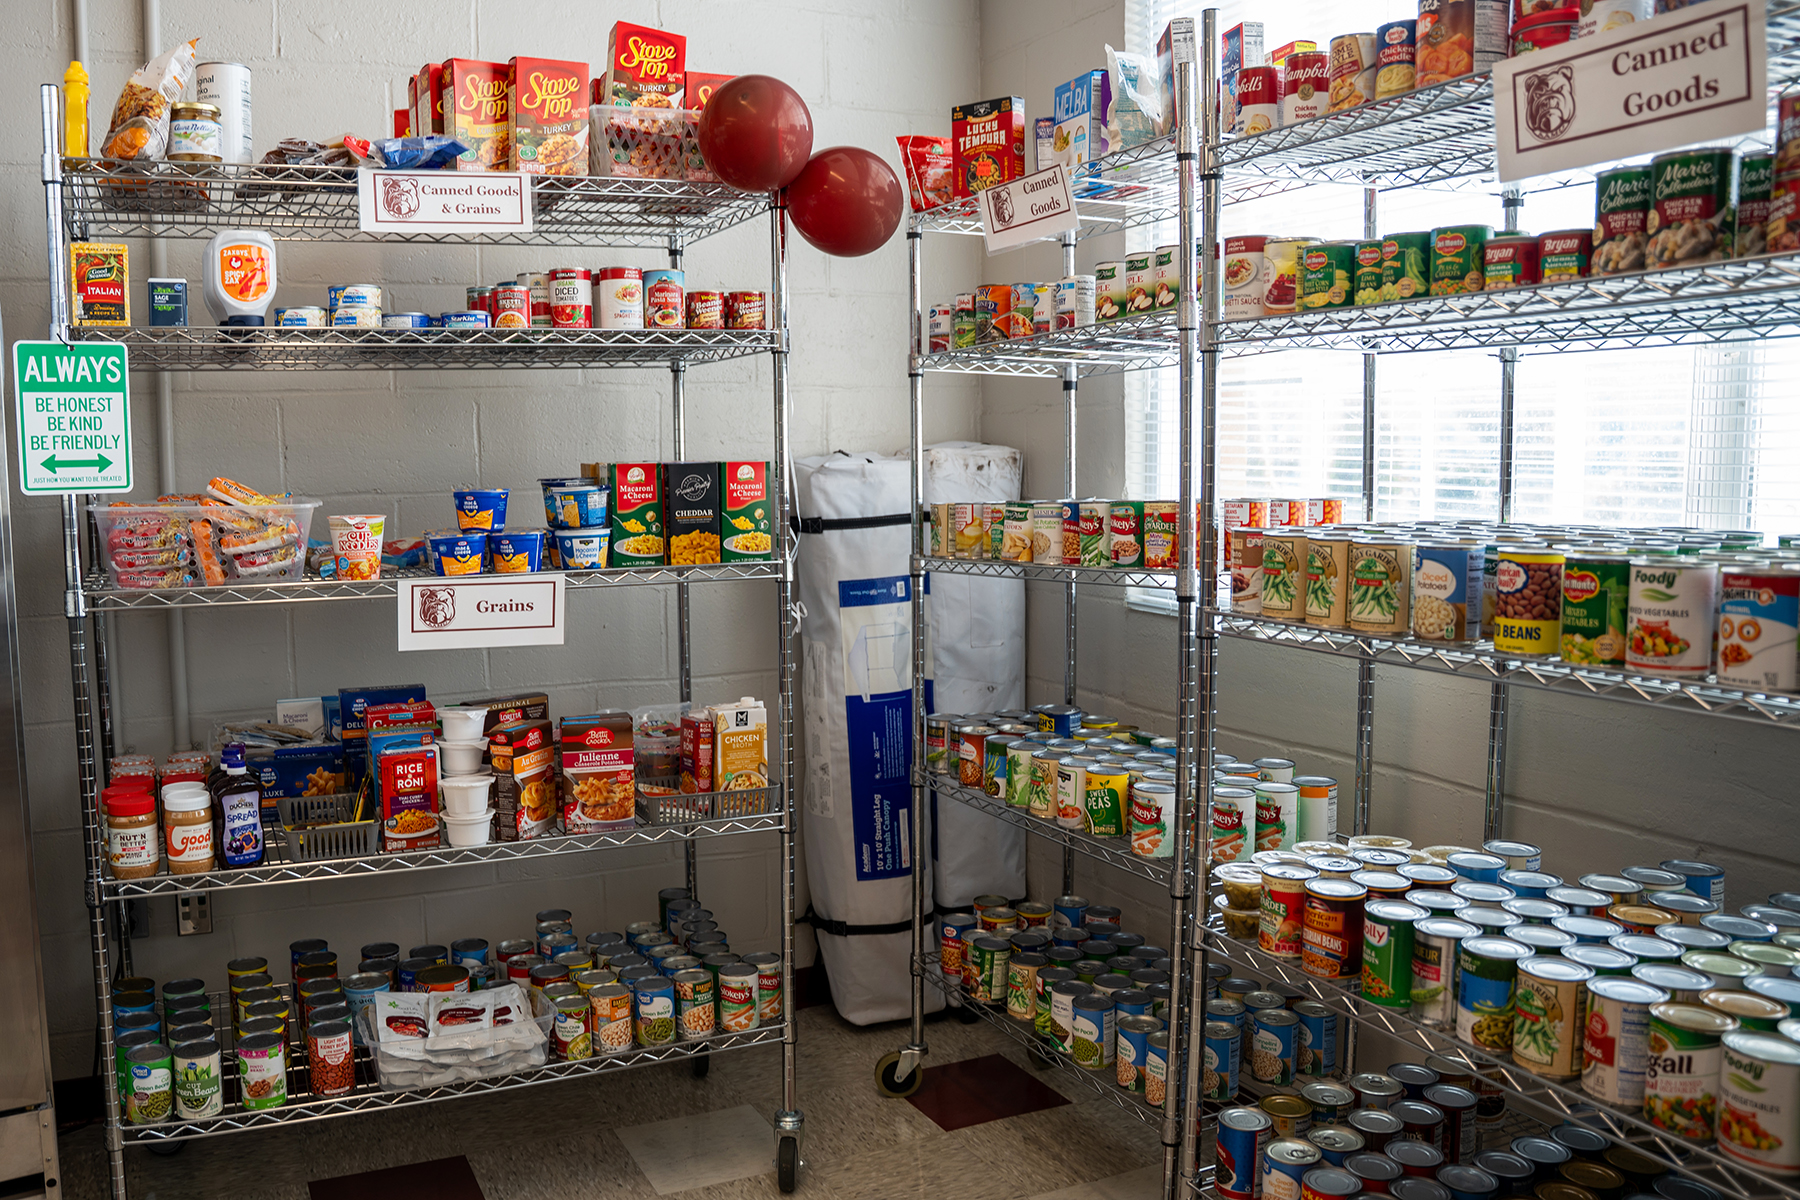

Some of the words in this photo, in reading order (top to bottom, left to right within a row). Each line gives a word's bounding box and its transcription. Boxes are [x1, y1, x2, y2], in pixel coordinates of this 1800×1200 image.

[620, 36, 676, 68] Stove
[1380, 45, 1415, 59] Chicken
[1611, 20, 1729, 76] Canned
[1381, 52, 1412, 63] Noodle
[639, 60, 668, 79] Top
[522, 72, 580, 110] Stove
[639, 83, 667, 92] TURKEY
[1623, 74, 1720, 117] Goods
[542, 97, 572, 121] Top
[1055, 84, 1088, 124] MELBA
[1294, 105, 1318, 113] Chicken
[543, 123, 572, 135] TURKEY
[967, 120, 998, 137] LUCKY
[959, 131, 1006, 152] TEMPURA
[1656, 161, 1713, 187] Marie
[1022, 171, 1059, 195] Canned
[1656, 175, 1719, 200] Callender's
[421, 185, 473, 196] Canned
[477, 185, 519, 197] Goods
[442, 203, 452, 214] &
[456, 203, 501, 214] Grains
[1030, 197, 1061, 217] Goods
[1664, 198, 1703, 209] CHICKEN
[1608, 212, 1644, 222] CHICKEN
[1666, 208, 1683, 216] POT
[1685, 206, 1699, 214] PIE
[1754, 209, 1768, 217] PIE
[1627, 219, 1641, 227] PIE
[1227, 245, 1246, 253] preserve
[1445, 239, 1464, 247] Monte
[1544, 238, 1579, 251] Bryan
[1485, 246, 1514, 260] Bryan
[1547, 255, 1577, 263] Vienna
[225, 270, 245, 279] SPICY
[88, 286, 121, 296] ITALIAN
[555, 287, 578, 295] DICED
[696, 300, 722, 308] Beanee
[739, 300, 764, 308] Beanee
[695, 306, 722, 315] Weenee
[739, 307, 764, 315] Weenee
[450, 315, 476, 323] StarKist
[24, 356, 121, 383] ALWAYS
[35, 397, 54, 412] BE
[58, 397, 113, 412] HONEST
[48, 417, 66, 431] BE
[69, 416, 103, 431] KIND
[31, 436, 49, 450] BE
[53, 435, 120, 450] FRIENDLY
[620, 485, 654, 493] Macaroni
[729, 483, 763, 491] Macaroni
[675, 509, 714, 517] CHEDDAR
[347, 531, 372, 541] CUP
[338, 539, 379, 551] NOODLES
[1364, 550, 1398, 573] GARDEN
[1422, 571, 1449, 583] Diced
[1634, 570, 1677, 588] Foody
[1572, 578, 1596, 590] Monte
[476, 599, 534, 613] Grains
[1564, 606, 1588, 616] MIXED
[1644, 608, 1690, 618] VEGETABLES
[1502, 624, 1542, 641] BEANS
[492, 700, 530, 710] ORIGINAL
[684, 729, 693, 739] RICE
[725, 734, 759, 744] CHICKEN
[683, 741, 693, 752] RONI
[522, 758, 530, 766] Au
[530, 751, 548, 763] Gratin
[579, 753, 619, 762] Julienne
[397, 763, 423, 775] RICE
[397, 778, 423, 789] RONI
[229, 802, 254, 810] DUCHESS
[873, 794, 881, 809] Leg
[1088, 796, 1111, 809] PEAS
[227, 810, 258, 823] SPREAD
[874, 809, 882, 840] Straight
[181, 828, 211, 846] good
[862, 843, 870, 872] Academy
[1322, 932, 1342, 952] BEANS
[1420, 968, 1437, 979] peas
[720, 985, 750, 1002] Stokely's
[1079, 1027, 1093, 1036] Peas
[1254, 1036, 1277, 1047] Cannellini
[1723, 1050, 1765, 1080] Foody
[1149, 1068, 1164, 1076] Beans
[194, 1085, 218, 1097] Beans
[1734, 1093, 1781, 1115] VEGETABLES
[1268, 1180, 1293, 1192] Northern
[1276, 1178, 1293, 1186] Great
[1274, 1189, 1292, 1199] Beans
